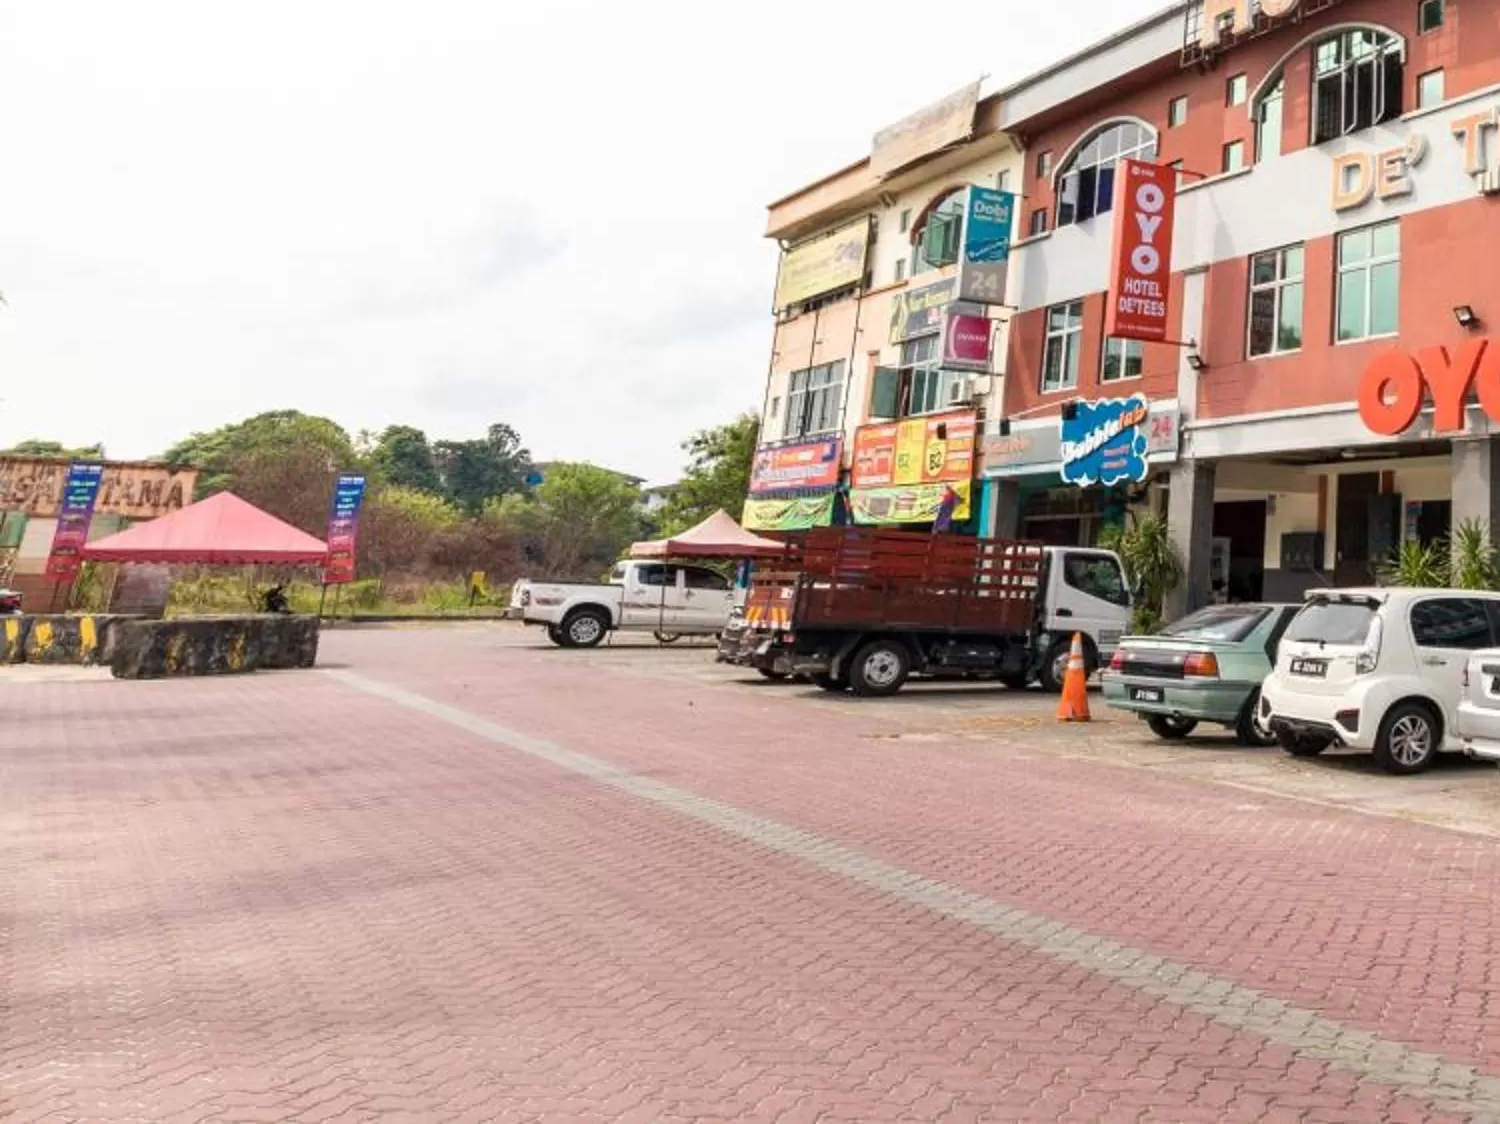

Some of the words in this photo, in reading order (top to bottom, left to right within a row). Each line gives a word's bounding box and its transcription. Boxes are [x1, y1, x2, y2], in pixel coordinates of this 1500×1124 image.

[1130, 182, 1166, 276] OYO
[970, 270, 999, 291] 24
[1123, 277, 1163, 298] HOTEL
[1150, 415, 1172, 439] 24
